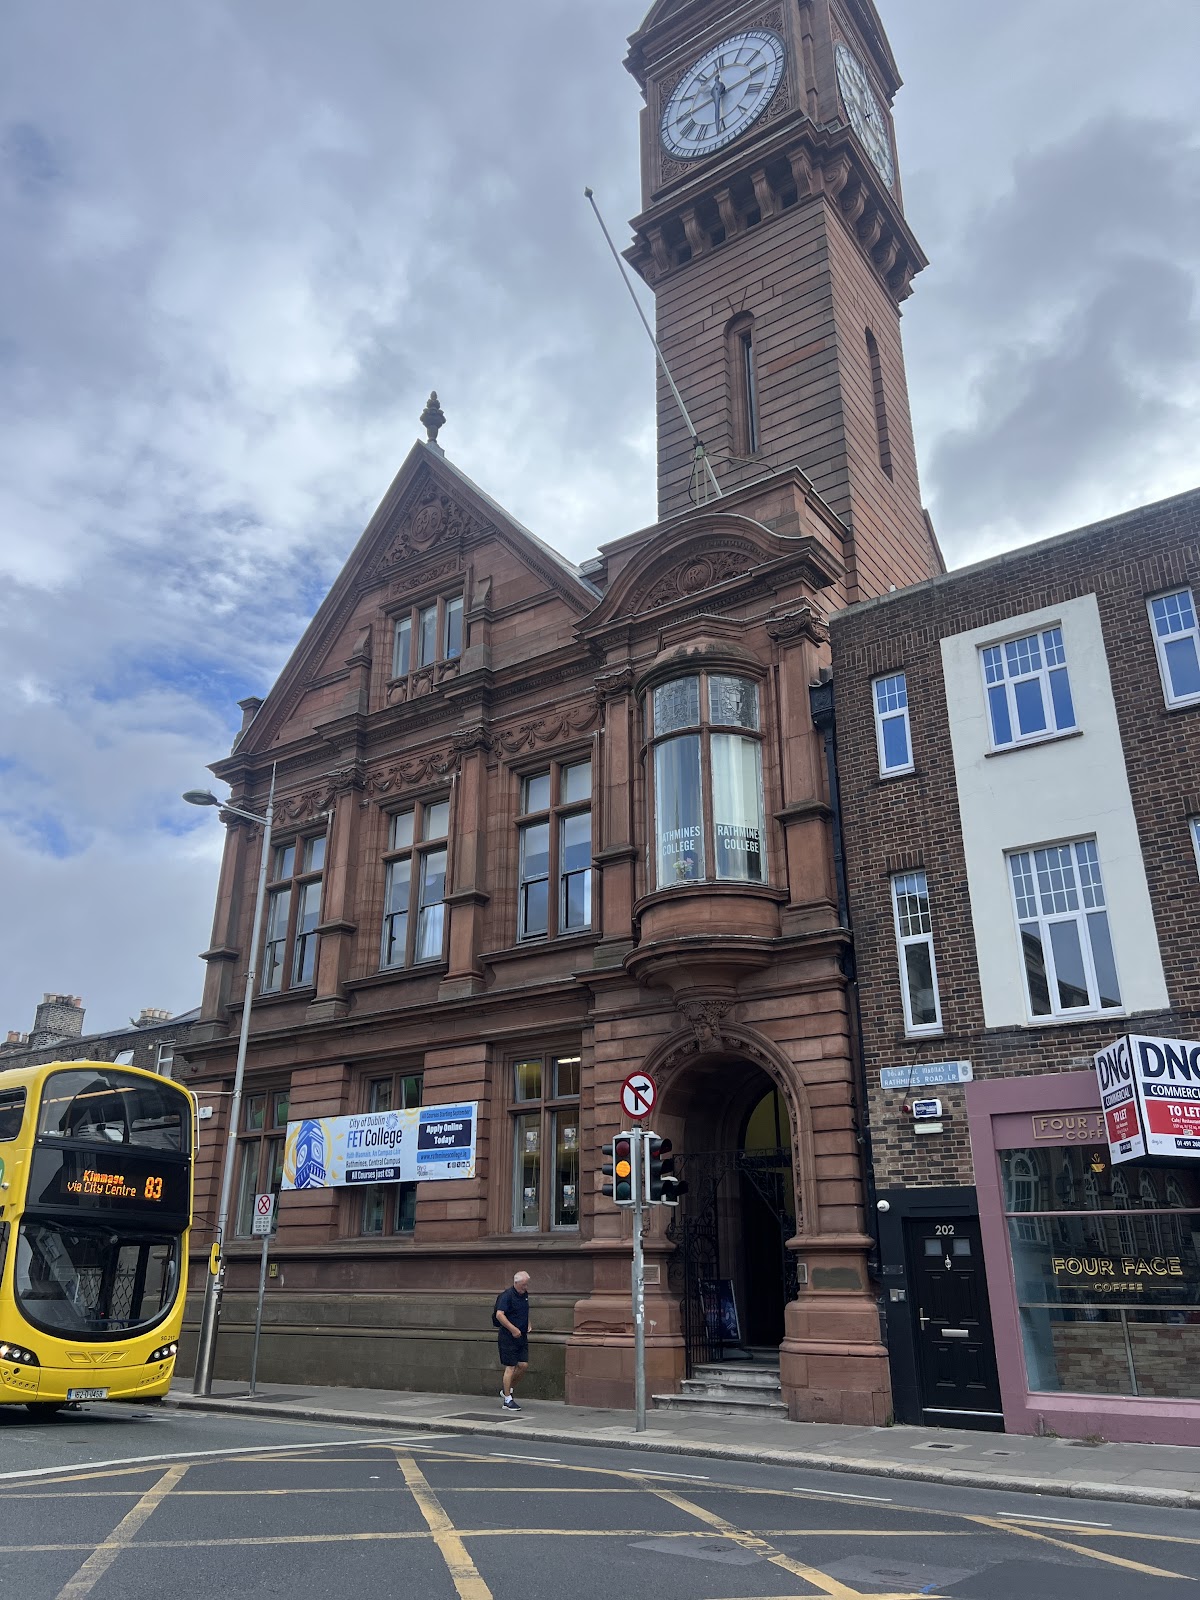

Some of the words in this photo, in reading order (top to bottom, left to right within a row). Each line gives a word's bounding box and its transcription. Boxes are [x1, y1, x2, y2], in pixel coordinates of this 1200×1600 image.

[662, 825, 701, 843] ATHMINES
[662, 840, 695, 856] COLLEGE
[724, 838, 760, 853] COLLEGE
[961, 1066, 969, 1076] 6
[1097, 1043, 1132, 1091] DNG
[924, 1074, 943, 1083] ROAD
[1167, 1105, 1182, 1117] TO
[1183, 1106, 1200, 1118] LET
[349, 1118, 359, 1129] City
[361, 1117, 367, 1127] of
[367, 1115, 386, 1126] Dublin
[426, 1123, 443, 1134] Apply
[444, 1123, 463, 1132] Online
[1041, 1116, 1087, 1131] FOUR
[347, 1130, 364, 1148] FET
[365, 1127, 402, 1149] College
[434, 1135, 455, 1145] Today!
[1066, 1128, 1104, 1140] COFF
[369, 1158, 383, 1167] Central
[384, 1157, 401, 1166] Campus
[83, 1170, 125, 1185] Kimmage
[358, 1170, 375, 1179] Courses
[376, 1169, 384, 1180] just
[67, 1180, 82, 1192] via
[84, 1182, 102, 1194] City
[105, 1183, 137, 1197] Centre
[144, 1177, 163, 1199] 83
[935, 1225, 954, 1235] 202
[1052, 1257, 1115, 1275] FOUR
[1121, 1257, 1183, 1275] FACE
[1093, 1282, 1144, 1293] COFFEE
